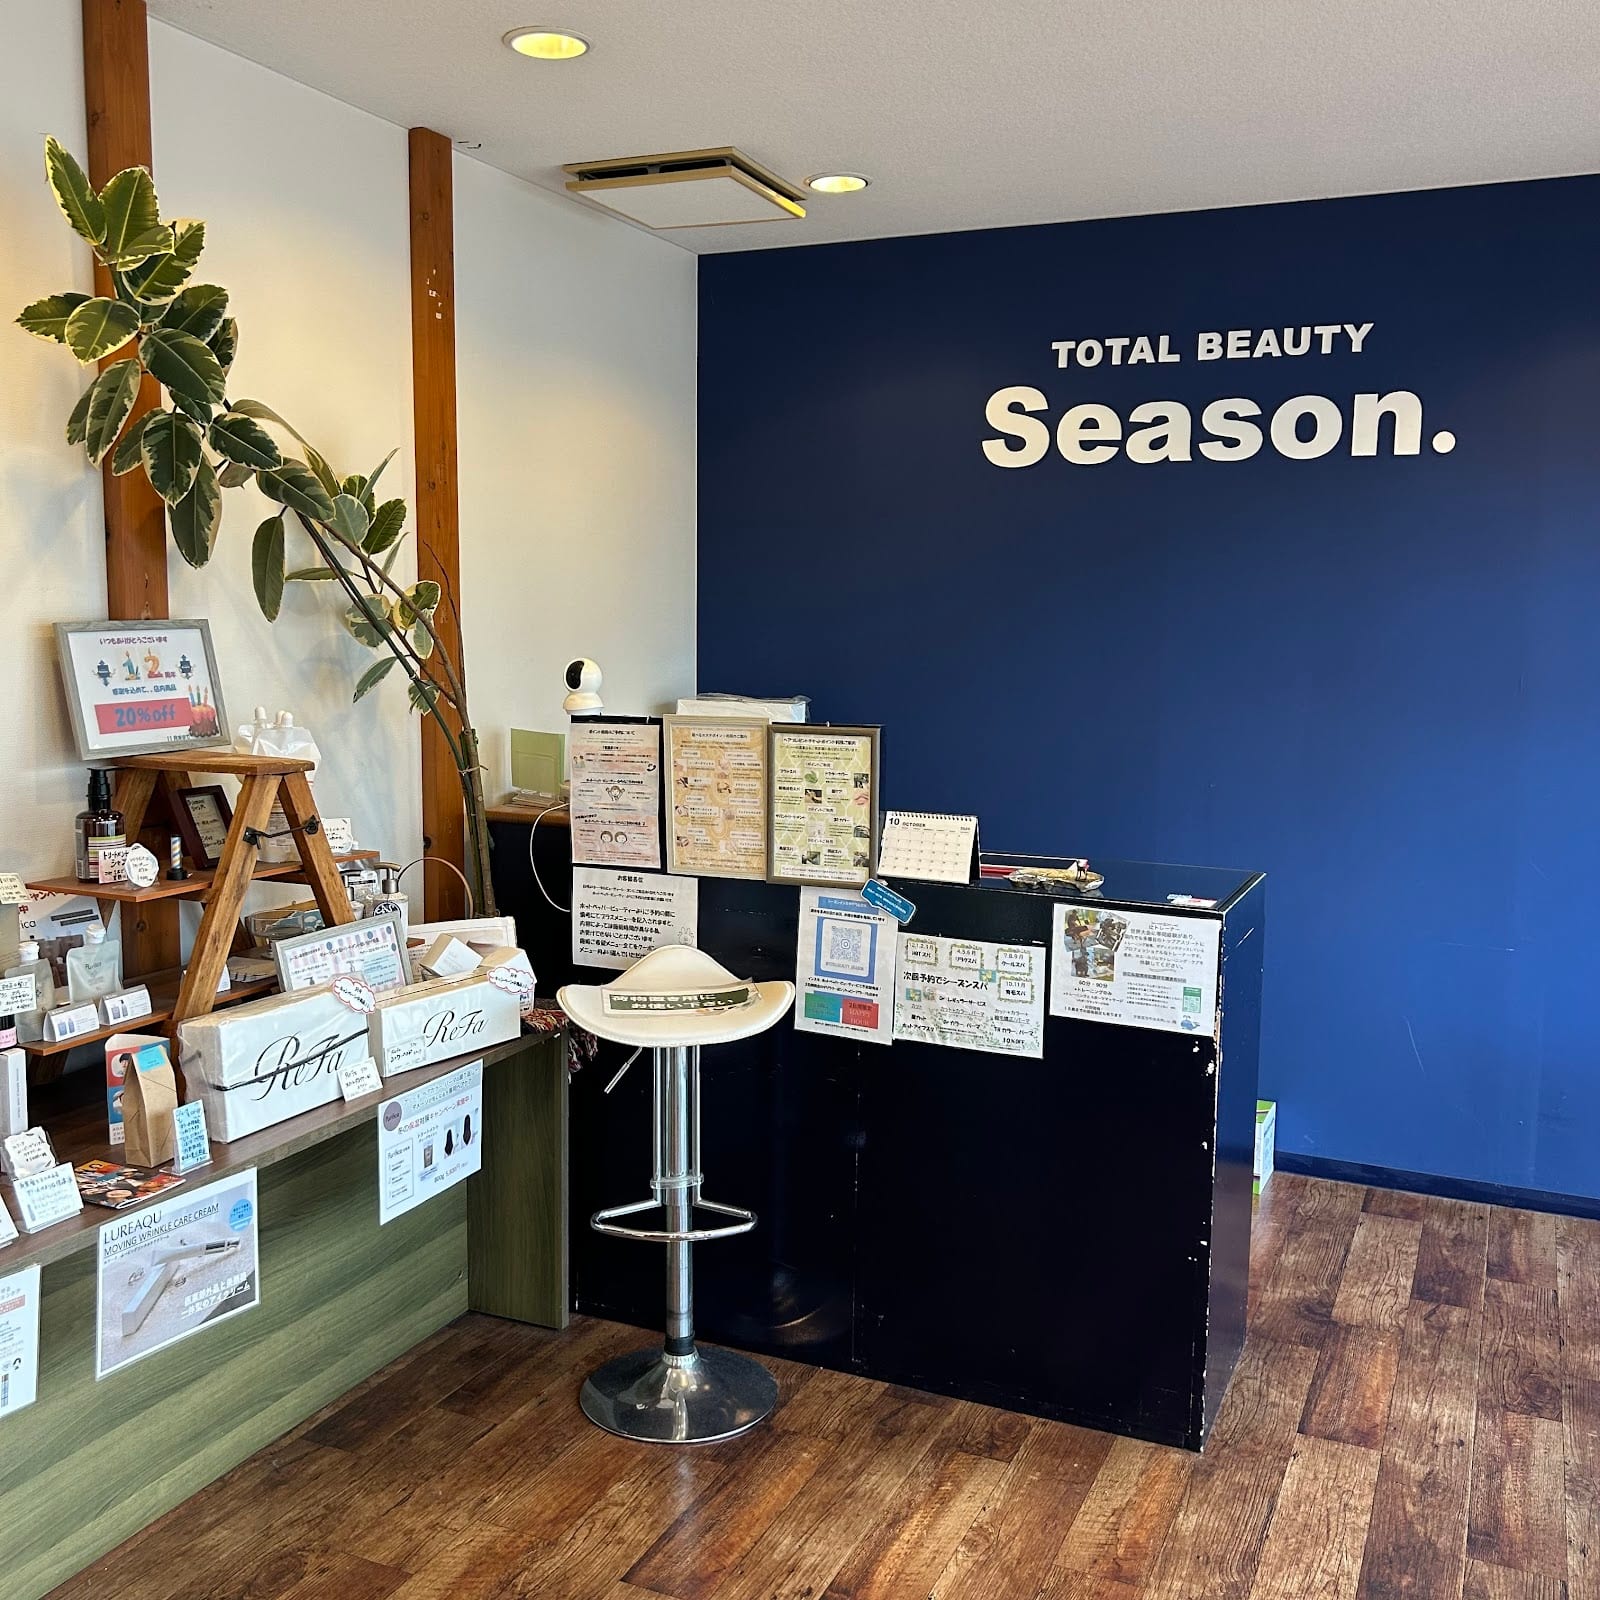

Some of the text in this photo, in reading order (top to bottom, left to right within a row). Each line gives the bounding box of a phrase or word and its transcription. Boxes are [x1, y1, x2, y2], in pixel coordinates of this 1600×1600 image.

[1051, 323, 1375, 368] TOTAL BEAUTY
[981, 386, 1457, 468] Season.
[889, 817, 900, 826] 10
[903, 971, 988, 991] 次回予約でシーズンスパ
[423, 1007, 489, 1047] ReFa
[249, 1030, 349, 1101] ReFa
[104, 1210, 163, 1245] LUREAQU
[104, 1236, 138, 1257] MOVING
[138, 1223, 172, 1243] WRINKLE
[173, 1214, 193, 1229] CARE
[193, 1203, 220, 1221] CREAM
